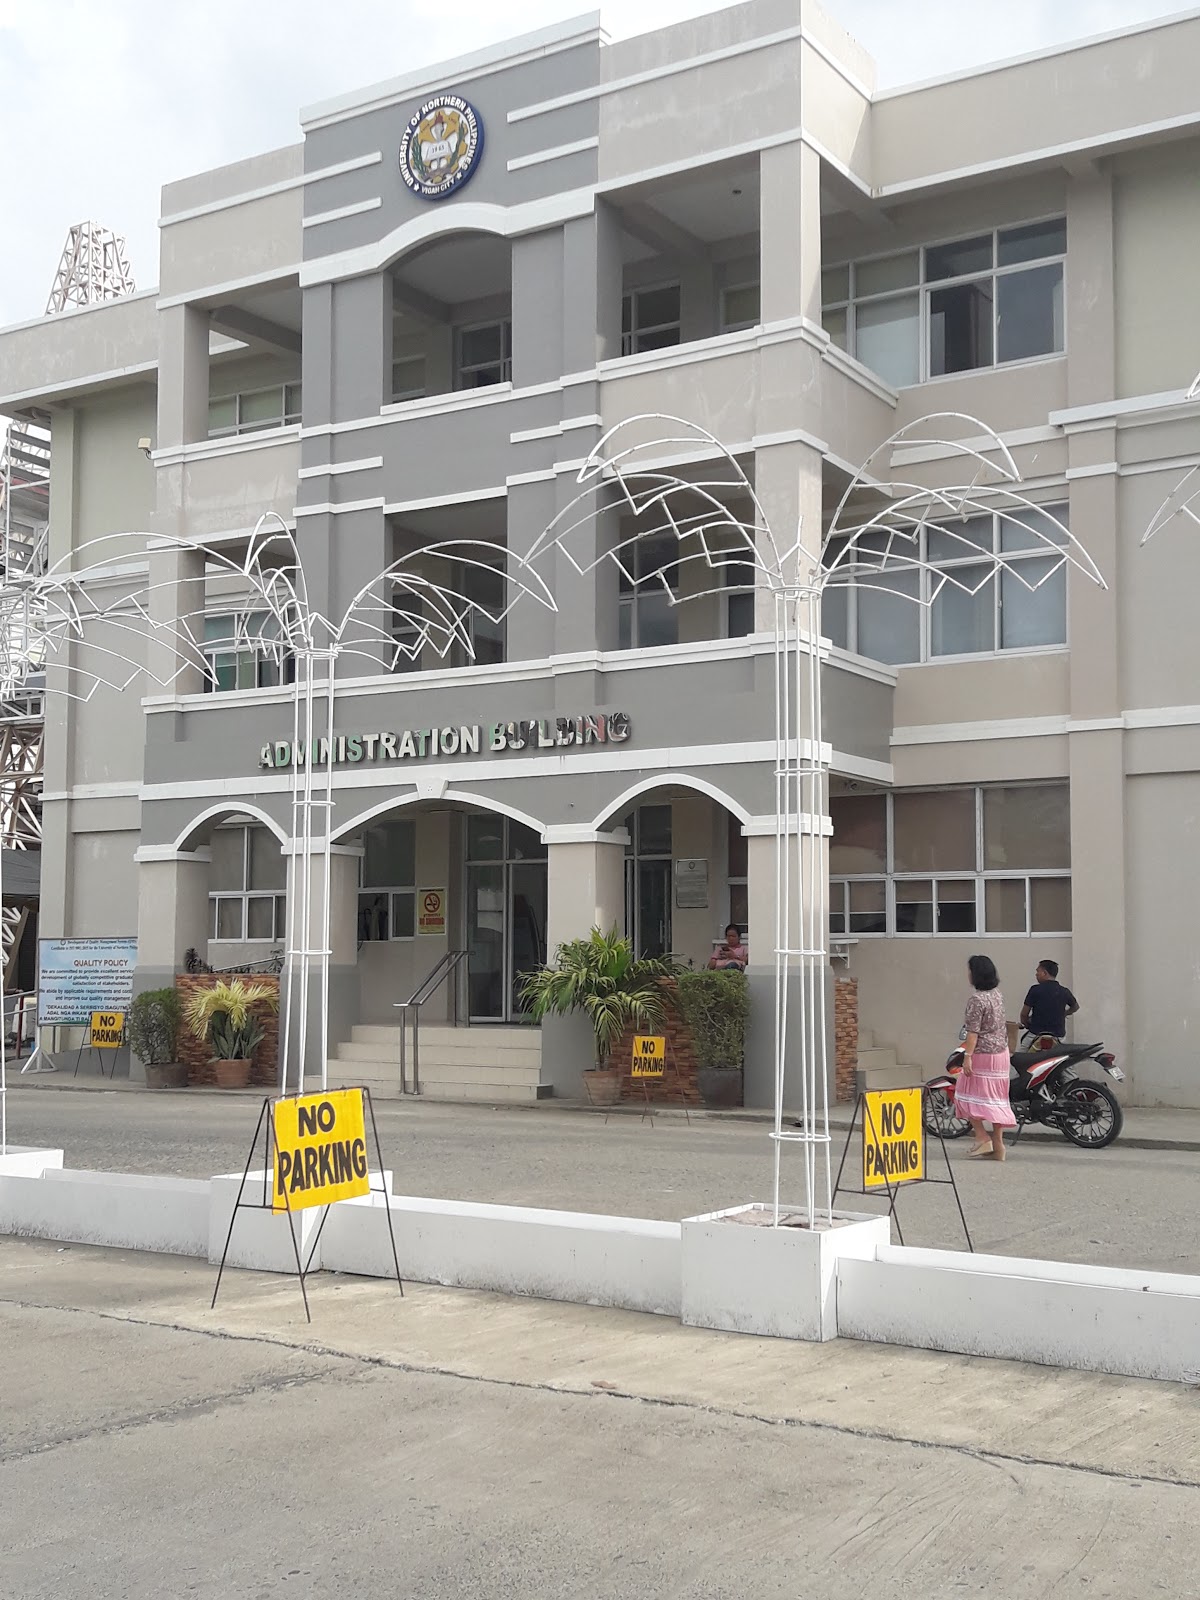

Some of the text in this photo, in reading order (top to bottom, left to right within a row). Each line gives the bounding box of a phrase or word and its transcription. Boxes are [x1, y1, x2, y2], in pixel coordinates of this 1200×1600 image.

[399, 96, 478, 187] UNIVERSITY OF NORTHERN PHILIPPINES
[421, 178, 455, 194] VIGAN CITY
[257, 712, 632, 769] ADMINISTRATION BUILDING
[74, 959, 102, 967] QUALITY
[99, 1015, 116, 1027] NO
[92, 1028, 122, 1042] PARKING
[642, 1040, 656, 1054] NO
[633, 1056, 664, 1072] PARKING
[298, 1101, 336, 1138] NO
[881, 1102, 906, 1138] NO
[278, 1138, 367, 1196] PARKING
[866, 1140, 918, 1177] PARKING
